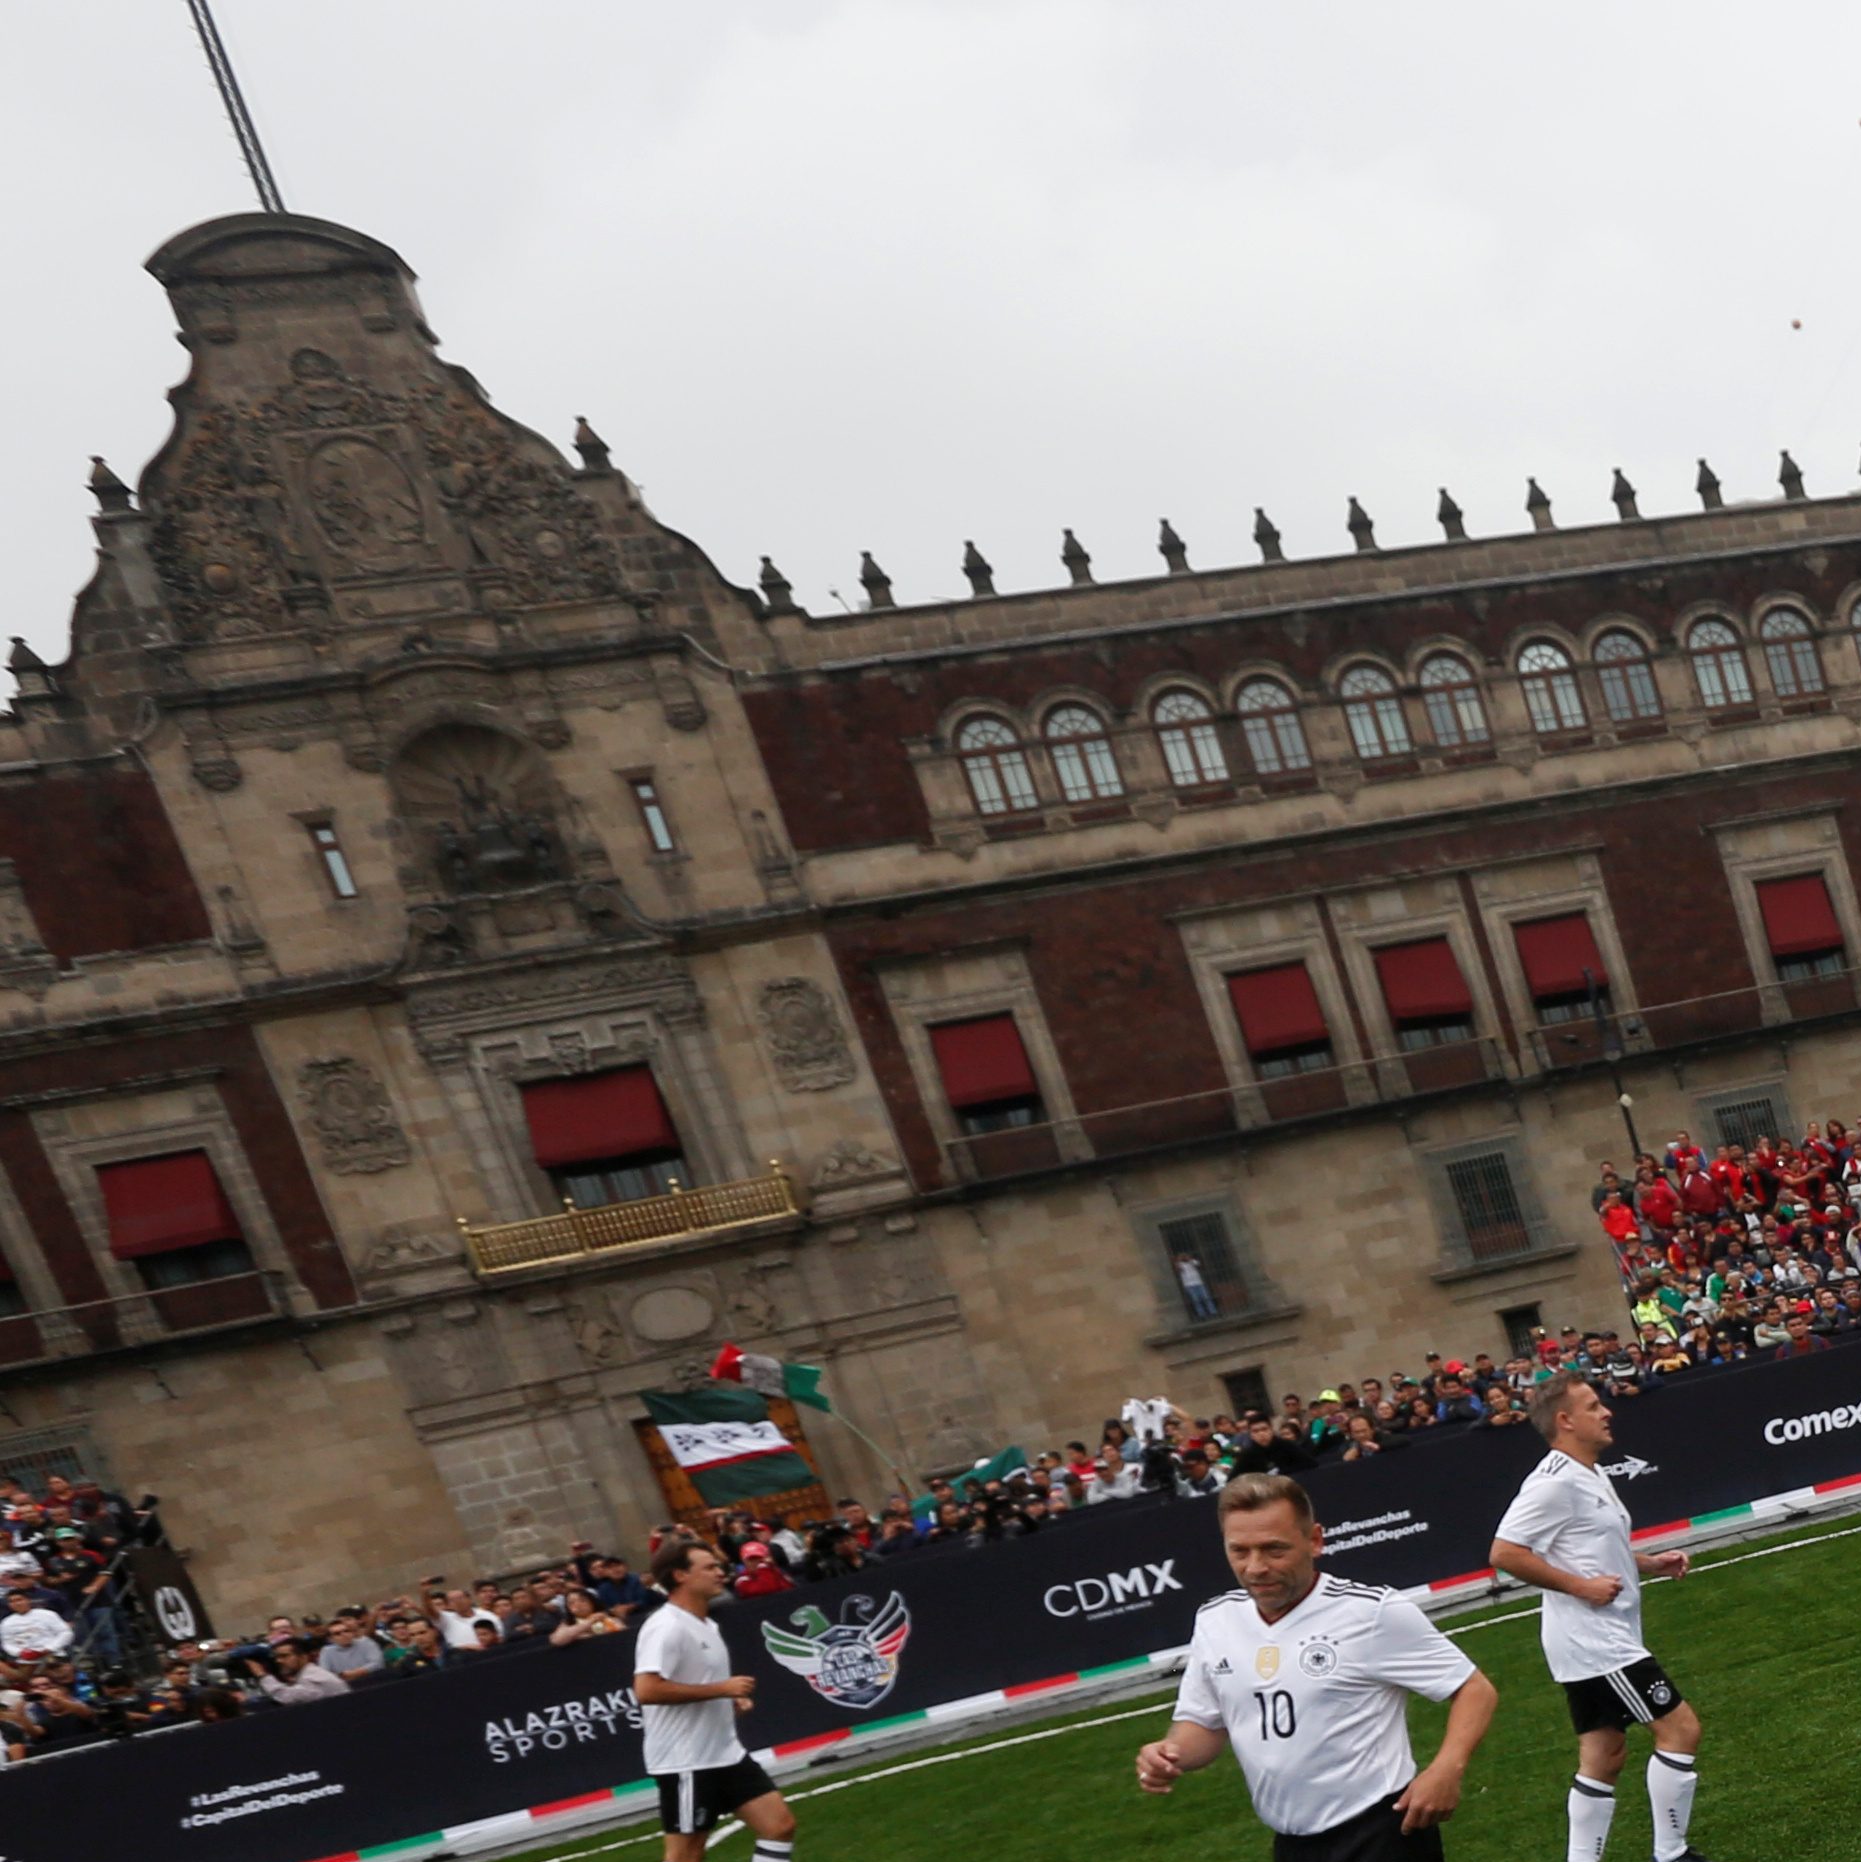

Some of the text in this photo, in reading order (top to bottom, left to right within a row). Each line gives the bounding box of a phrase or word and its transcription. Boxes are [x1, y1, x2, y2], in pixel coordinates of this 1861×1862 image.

[1320, 1522, 1429, 1556] apitalDelDeporte
[1321, 1510, 1411, 1538] LasRevanchas
[1044, 1558, 1184, 1618] CDMX
[815, 1656, 889, 1688] REVANCHAS
[486, 1687, 639, 1744] ALAZRAKI
[489, 1709, 645, 1763] SPORTS
[1253, 1690, 1296, 1741] 10
